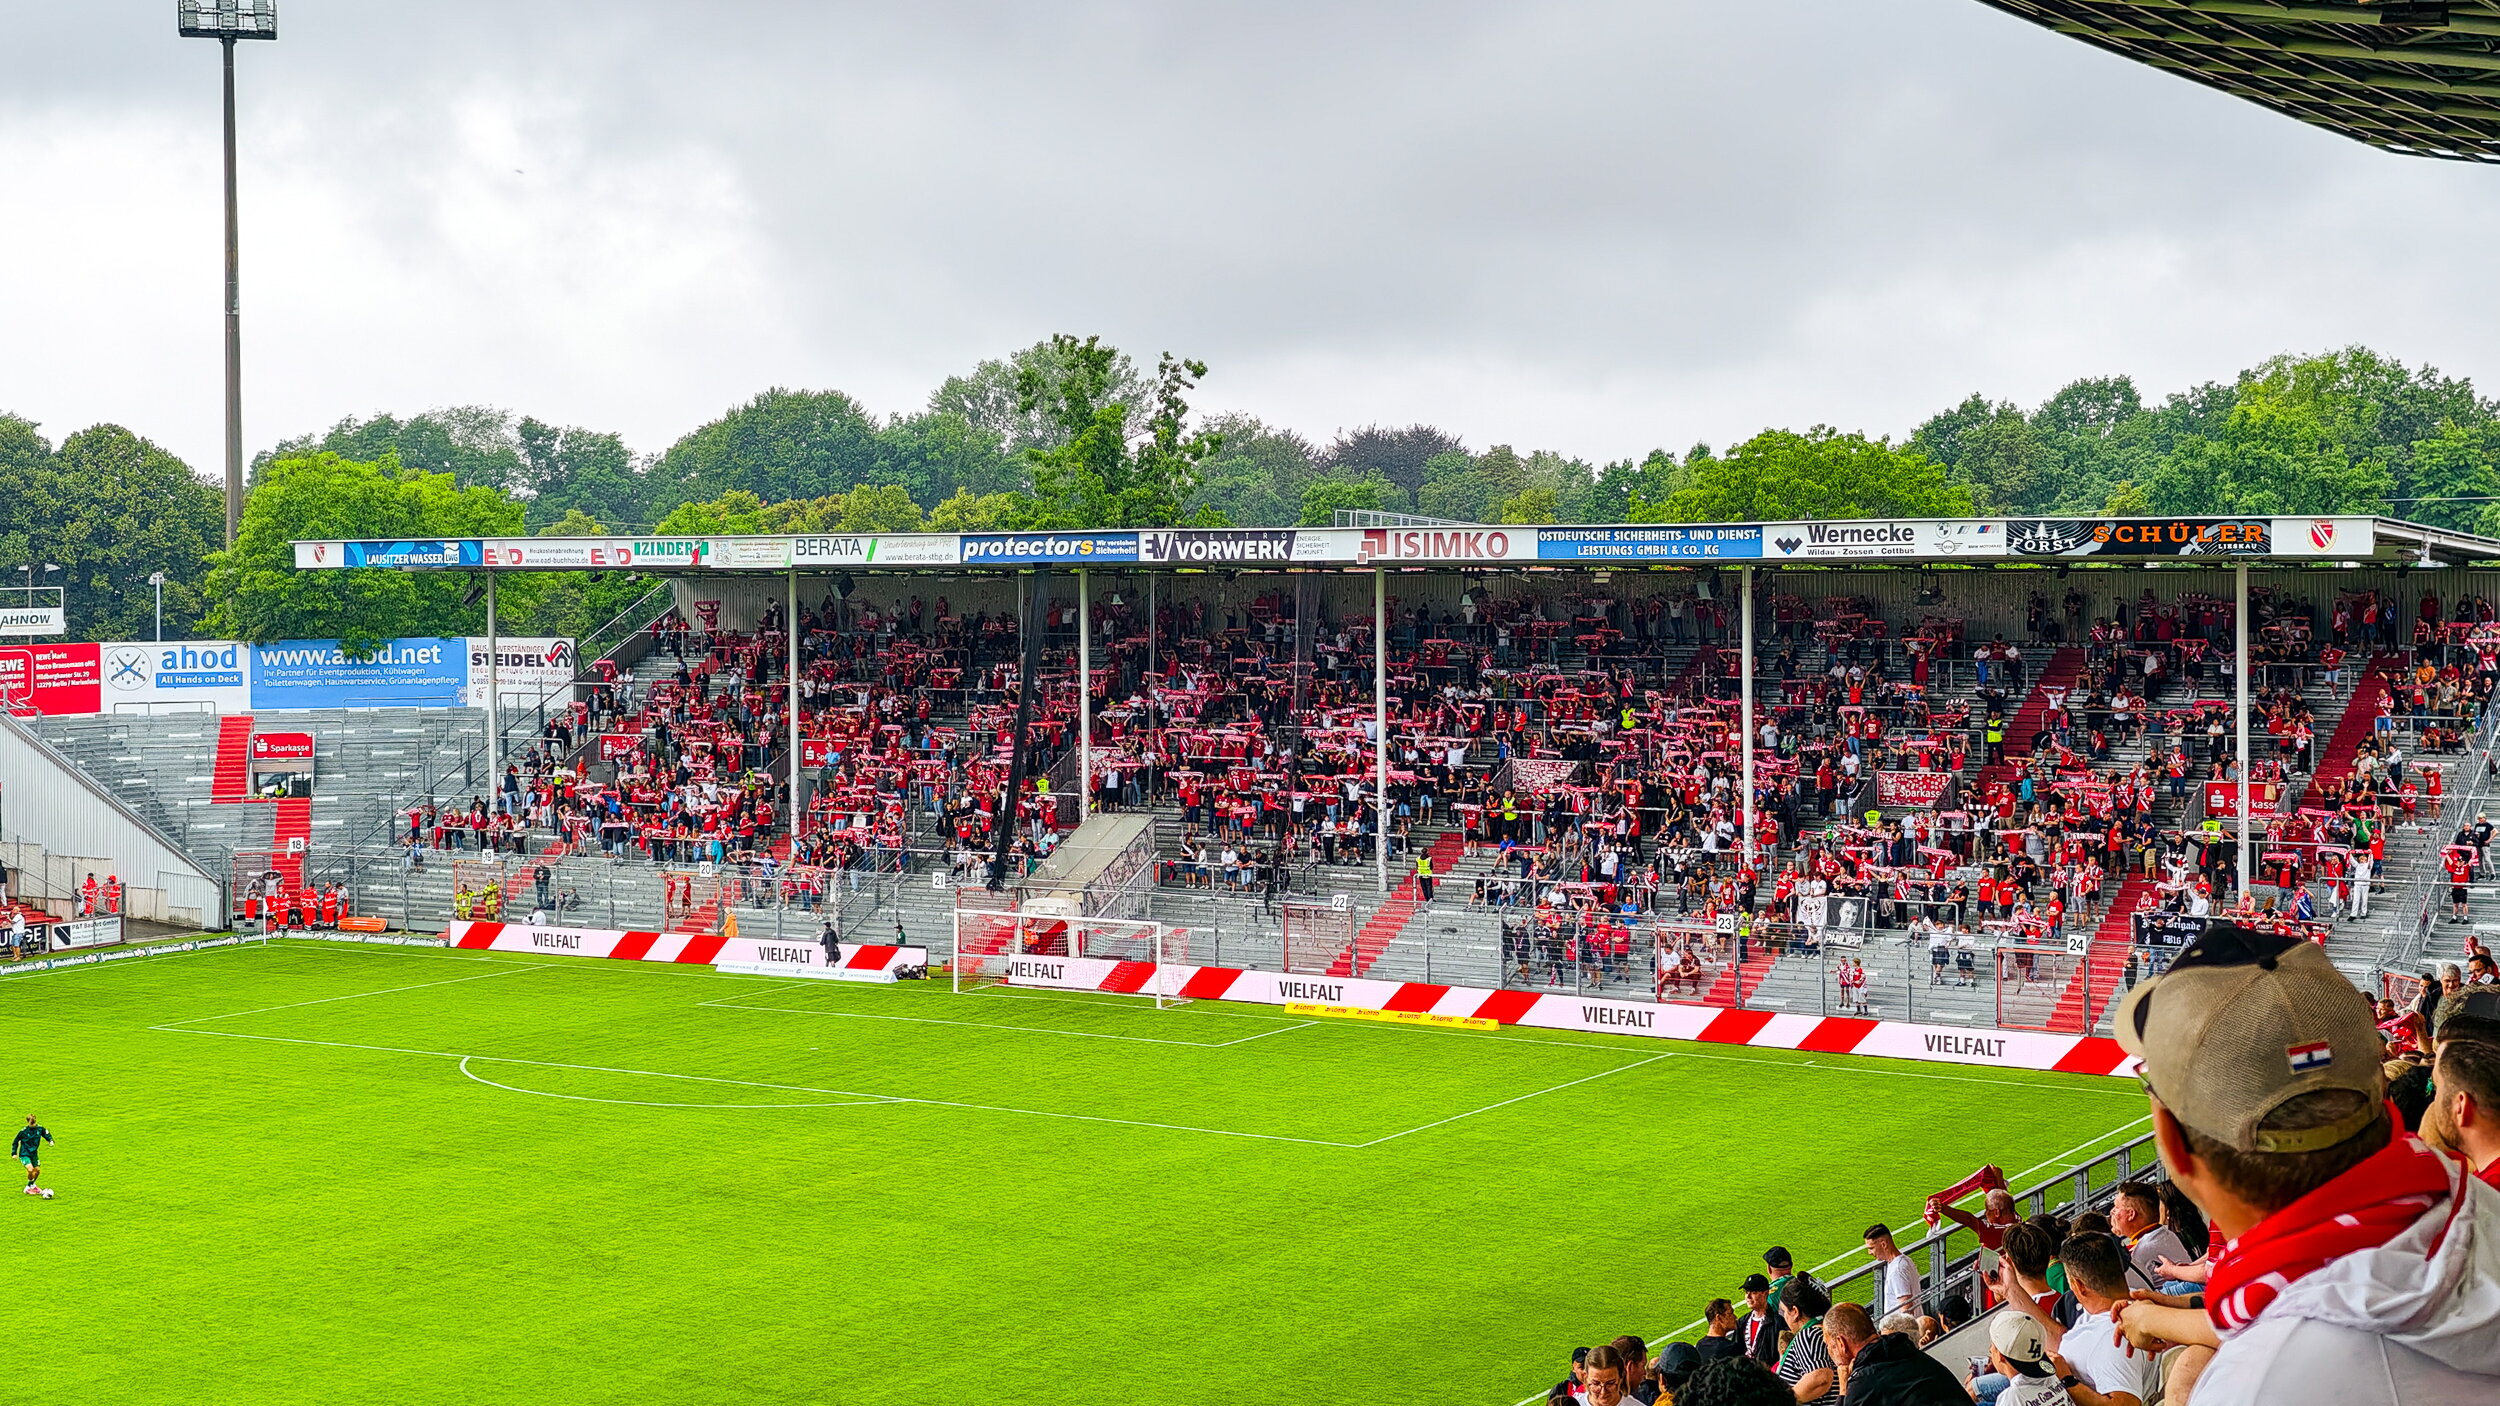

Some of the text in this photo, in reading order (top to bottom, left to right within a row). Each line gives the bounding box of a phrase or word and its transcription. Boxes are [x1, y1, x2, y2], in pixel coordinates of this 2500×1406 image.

[1174, 532, 1287, 540] ELEKTRO
[1539, 529, 1761, 542] OSTDEUTSCHE SICHERHEITS- UND DIENST-
[1806, 523, 1915, 543] Wernecke
[2092, 522, 2264, 543] SCHÜLER
[641, 541, 693, 556] ZINDER
[796, 539, 862, 556] BERATA
[962, 536, 1093, 561] protectors
[1095, 546, 1137, 555] Sicherheit!
[1175, 540, 1289, 560] VORWERK
[1394, 532, 1509, 558] ISIMKO
[1577, 544, 1719, 556] LEISTUNGS GMBH & CO. KG
[1807, 547, 1836, 555] Wildau
[1842, 547, 1874, 555] Zossen
[1881, 546, 1915, 555] Cottbus
[2012, 537, 2077, 551] FORST
[367, 553, 443, 565] LAUSITZER WASSER
[445, 553, 459, 563] LWG
[484, 541, 523, 565] EAD
[591, 541, 631, 565] EAD
[885, 553, 954, 562] www.berata-stbg.de
[525, 556, 589, 564] www.ead-buchholz.de
[471, 644, 545, 653] BAUSHVERSTÄNDIGER
[35, 653, 51, 661] REWE
[161, 645, 237, 670] ahod
[160, 673, 239, 684] All Hands on Deck
[263, 666, 425, 678] Ihr Partner für Eventproduktion, Kühlwagen
[263, 676, 460, 688] Toilettenwagen, Hauswartservice, Grünanlagenpflege
[270, 744, 311, 754] Sparkasse
[291, 840, 302, 850] 18
[700, 864, 711, 875] 20
[934, 875, 944, 886] 21
[1333, 896, 1345, 908] 22
[1718, 917, 1732, 930] 23
[532, 932, 582, 950] VIELFALT
[1823, 933, 1862, 948] PHILIPP
[2069, 938, 2084, 952] 24
[758, 946, 812, 964] VIELFALT
[1279, 981, 1344, 1001] VIELFALT
[1582, 1005, 1655, 1028] VIELFALT
[1924, 1034, 2006, 1058] VIELFALT
[2027, 1338, 2042, 1359] LA
